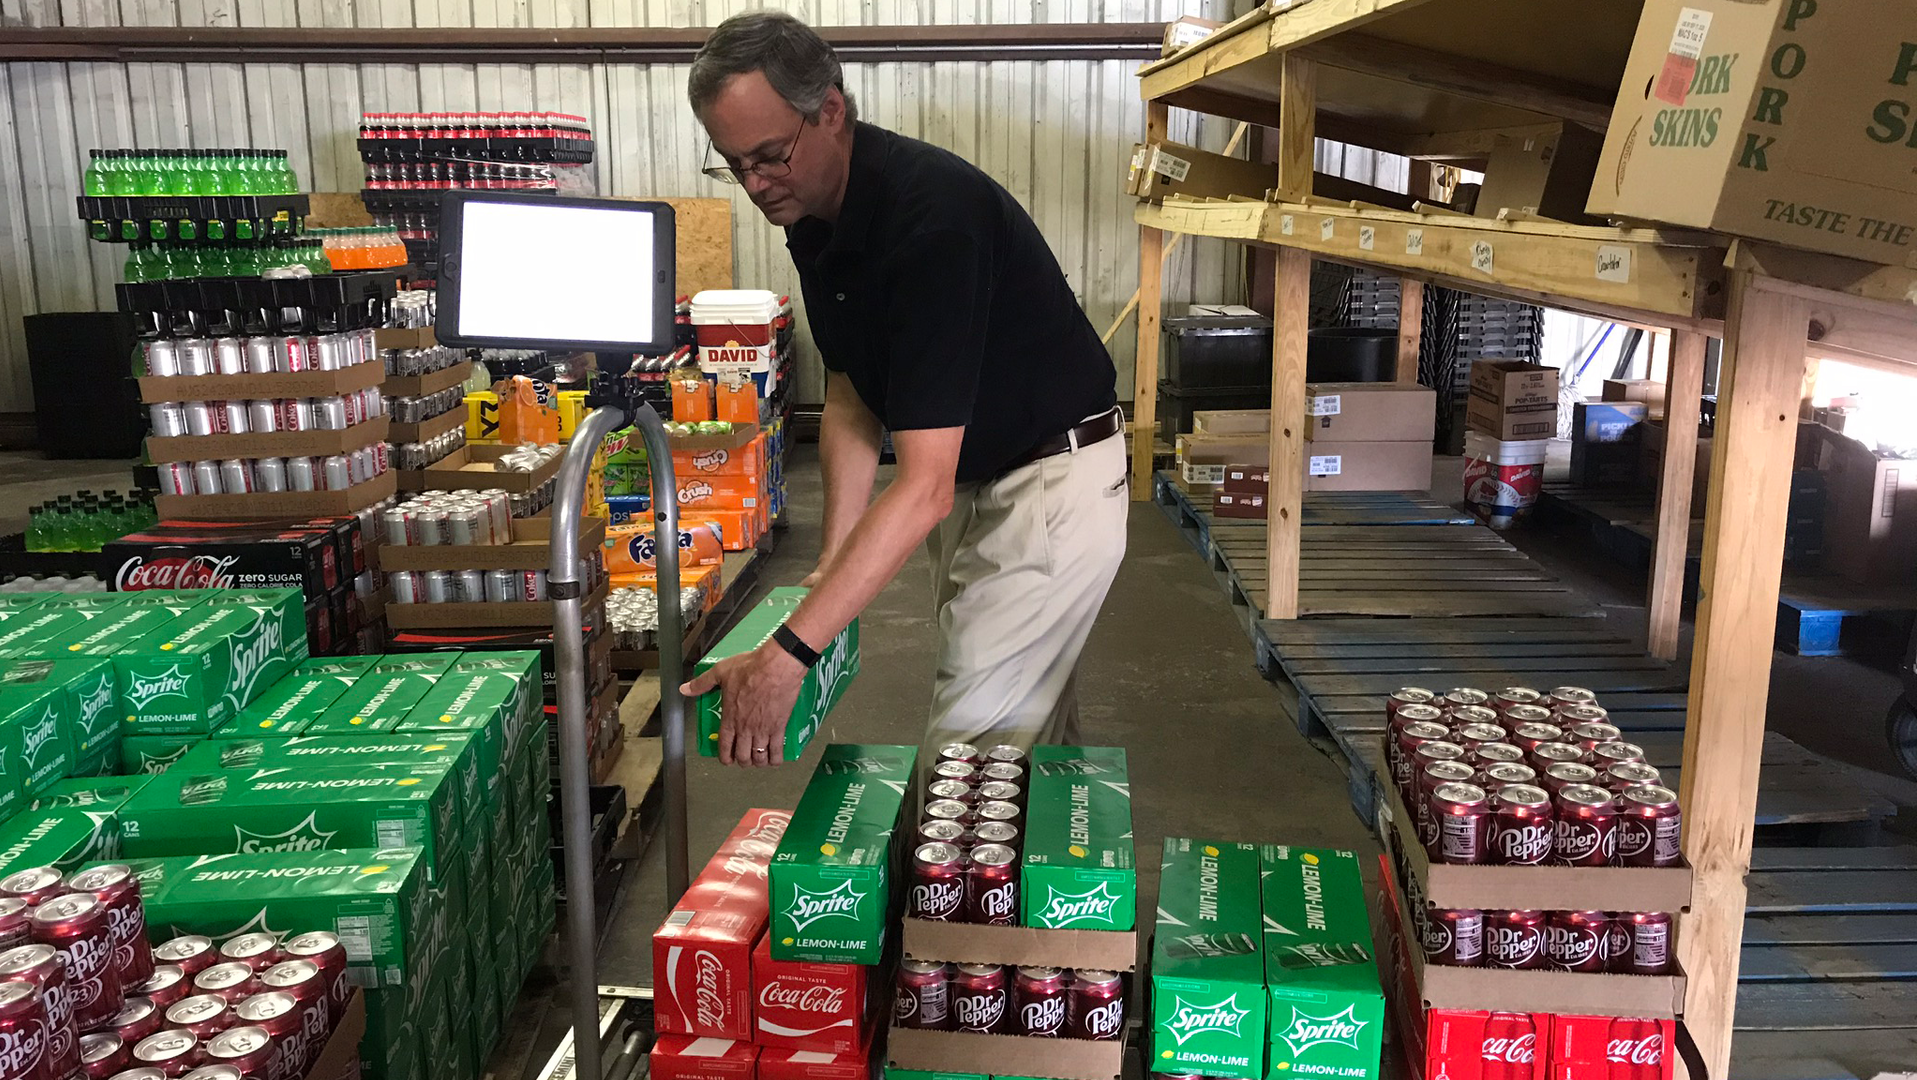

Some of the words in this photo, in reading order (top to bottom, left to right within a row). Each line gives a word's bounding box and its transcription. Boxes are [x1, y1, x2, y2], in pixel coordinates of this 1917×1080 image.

[1649, 107, 1722, 148] SKINS
[1764, 199, 1851, 234] TASTE
[1857, 217, 1916, 246] THE
[708, 349, 757, 362] DAVID
[217, 405, 228, 434] Coke
[287, 401, 299, 431] Coke
[677, 482, 713, 504] Crush
[239, 574, 265, 582] zero
[268, 574, 302, 582] SUGAR
[526, 576, 536, 601] Coke
[171, 609, 234, 644] LEMON-LIME
[231, 619, 279, 692] Sprite
[131, 677, 183, 700] Sprite
[267, 680, 322, 720] LEMON-LIME
[358, 677, 406, 718] LEMON-LIME
[446, 675, 489, 715] LEMON-LIME
[82, 688, 112, 716] Sprite
[138, 713, 197, 722] LEMON-LIME
[25, 719, 56, 754] Sprite
[87, 721, 118, 747] LEMON-LIME
[286, 743, 425, 756] LEMON-LIME
[32, 753, 66, 783] LEMON-LIME
[251, 777, 396, 791] LEMON-LIME
[826, 782, 866, 844] LEMON-LIME
[1070, 784, 1089, 845] LEMON-LIME
[122, 821, 140, 832] 12
[1522, 825, 1545, 843] Dr
[1558, 820, 1580, 837] Dr
[191, 864, 360, 882] LEMON-LIME
[915, 885, 961, 914] Pepper
[930, 882, 950, 898] Dr
[1199, 856, 1218, 921] LEMON-LIME
[1302, 864, 1326, 931] LEMON-LIME
[107, 903, 130, 928] Dr
[793, 892, 855, 918] Sprite
[1046, 895, 1109, 921] Sprite
[69, 934, 98, 963] Dr
[796, 938, 867, 950] LEMON-LIME
[1486, 927, 1538, 959] Pepper
[1500, 926, 1522, 945] Dr
[1555, 926, 1578, 945] Dr
[695, 950, 725, 1032] Coca-Cola
[777, 974, 806, 982] ORIGINAL
[760, 981, 847, 1013] Coca-Cola
[971, 995, 993, 1009] Dr
[1043, 997, 1062, 1013] Dr
[956, 995, 1003, 1026] Pepper
[1173, 1006, 1237, 1030] Sprite
[1289, 1018, 1356, 1042] Sprite
[1176, 1052, 1249, 1066] LEMON-LIME
[1292, 1063, 1367, 1078] LEMON-LIME
